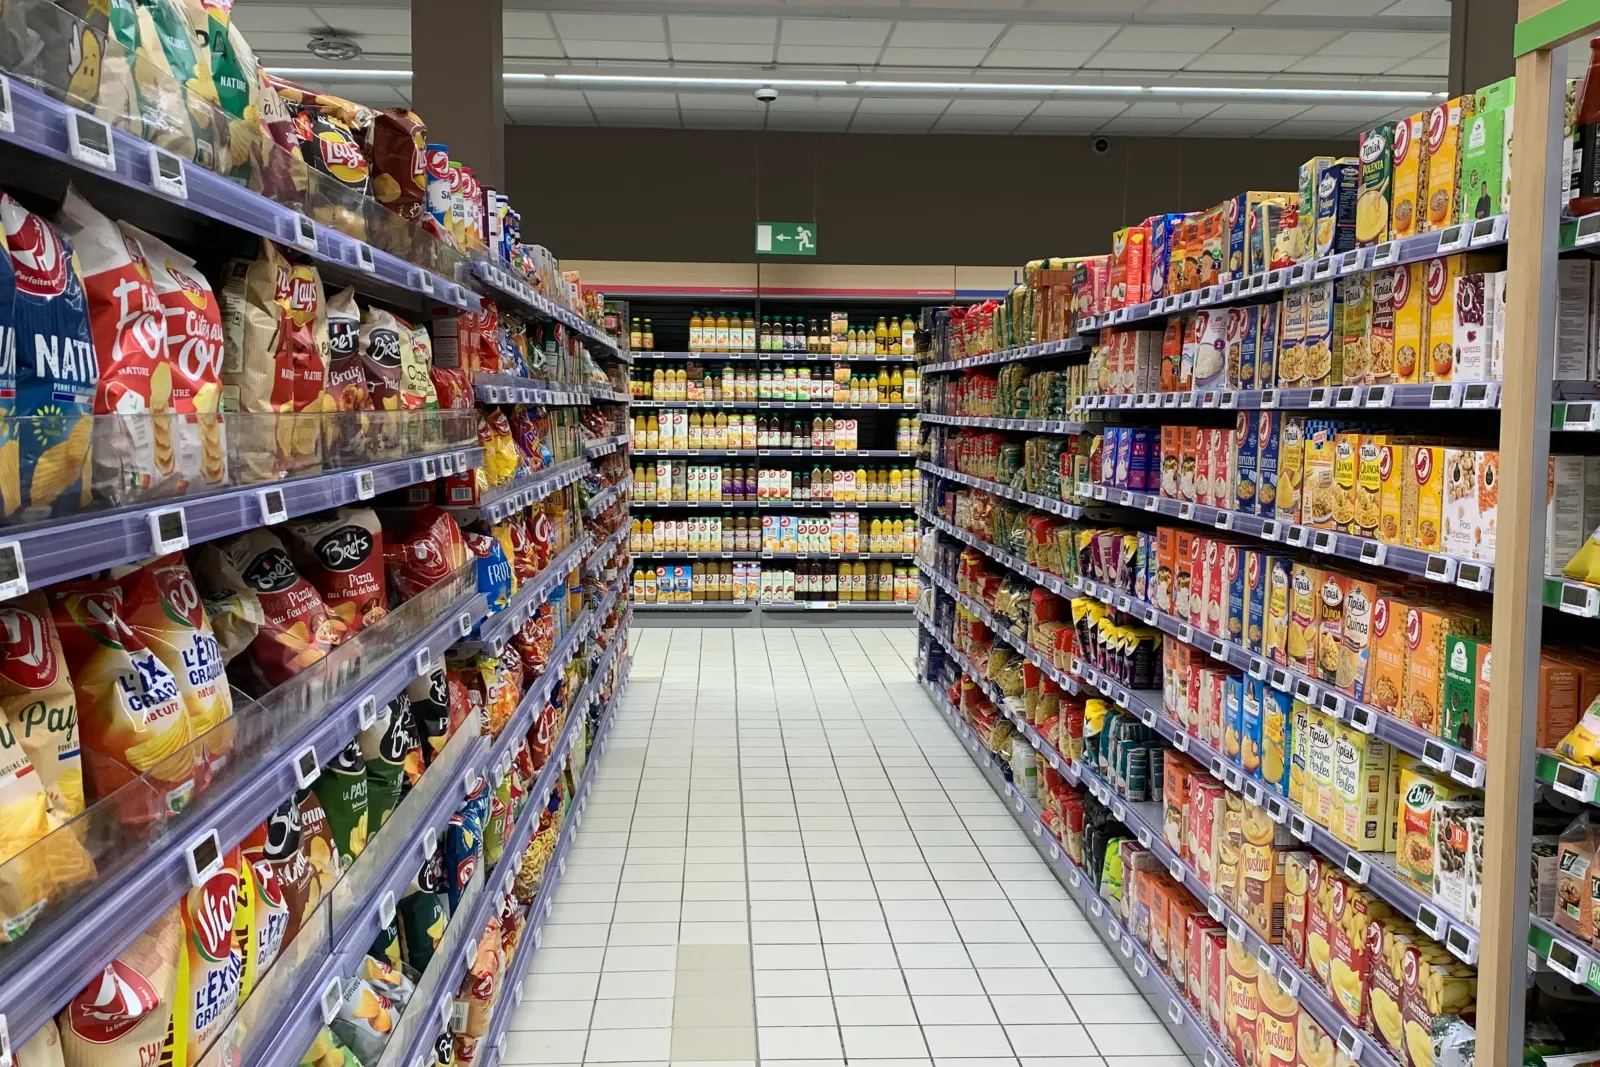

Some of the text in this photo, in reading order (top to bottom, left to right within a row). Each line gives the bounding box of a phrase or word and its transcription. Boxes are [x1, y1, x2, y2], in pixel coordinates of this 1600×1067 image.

[220, 75, 247, 93] NATURE
[1363, 139, 1381, 159] Tipiak
[1362, 160, 1384, 176] POLENTA
[15, 269, 52, 286] Parfaites
[1309, 290, 1324, 305] Tipiak
[1373, 280, 1393, 298] Tipiak
[1286, 297, 1302, 311] Tipiak
[1464, 356, 1481, 366] rouges
[1285, 429, 1299, 441] Tipiak
[1337, 445, 1350, 457] Tipiak
[1361, 447, 1377, 459] Tipiak
[1337, 461, 1352, 472] QUINOA
[1361, 462, 1379, 474] QUINOA
[1460, 520, 1471, 529] Pois
[1451, 530, 1470, 541] chiches
[322, 533, 369, 565] Brets
[349, 572, 375, 588] Pizza
[1294, 577, 1311, 592] Tipiak
[288, 586, 313, 605] Pizza
[327, 583, 379, 599] au feu de bois
[1323, 586, 1339, 600] Tipiak
[272, 615, 285, 625] au
[287, 604, 303, 620] feu
[307, 597, 321, 611] bois
[1322, 604, 1341, 620] QUINOA
[1347, 595, 1367, 612] Tipiak
[1346, 615, 1368, 635] Quinoa
[1296, 714, 1307, 730] Tip
[1309, 726, 1330, 746] Tipiak
[1309, 745, 1331, 763] Tendres
[1335, 740, 1354, 761] Tipiak
[1308, 755, 1330, 778] Perles
[1336, 773, 1355, 795] Perles
[1408, 784, 1433, 810] Ebly
[1241, 852, 1271, 874] Mousline
[197, 884, 238, 954] Vico
[1311, 912, 1328, 931] NATURE
[1335, 936, 1352, 957] NATURE
[1227, 983, 1257, 1011] Mousline
[1257, 1021, 1293, 1052] Mousline
